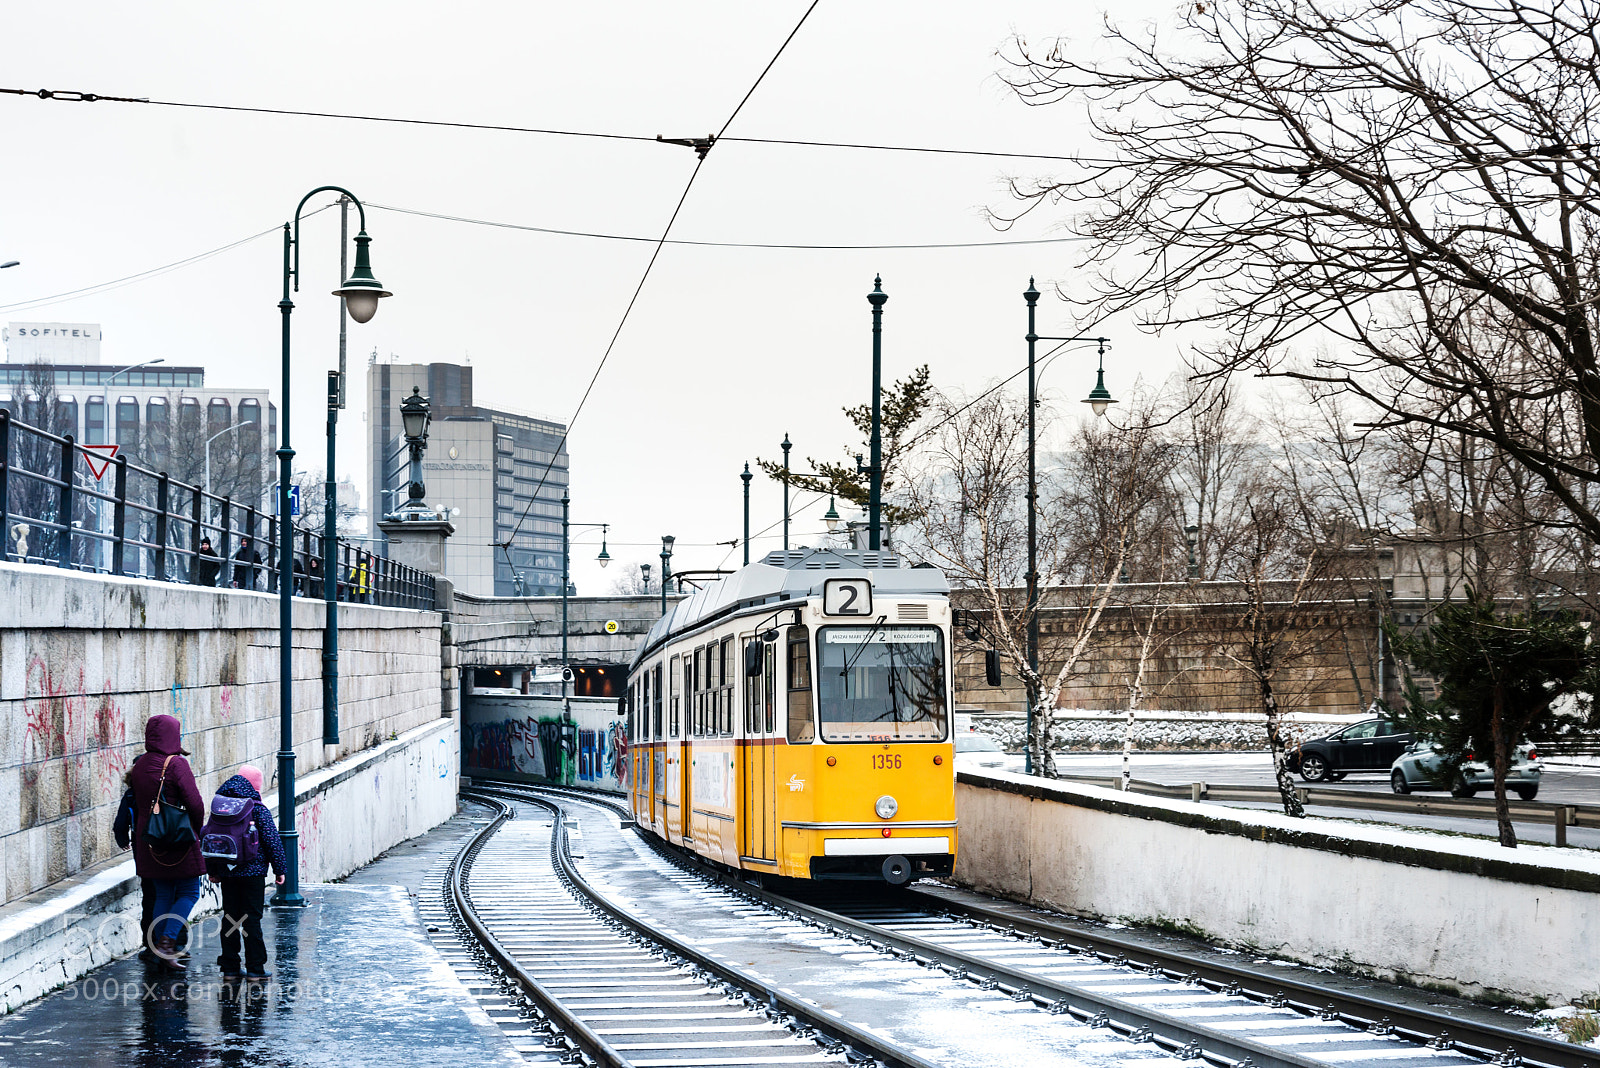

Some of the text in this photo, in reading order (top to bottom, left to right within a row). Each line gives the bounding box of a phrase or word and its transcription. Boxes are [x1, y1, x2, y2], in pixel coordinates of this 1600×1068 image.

[19, 328, 91, 338] SOFITEL
[422, 462, 491, 472] NTERCONTINENTAL
[838, 585, 859, 614] 2
[878, 631, 886, 642] 2
[872, 754, 902, 770] 1356
